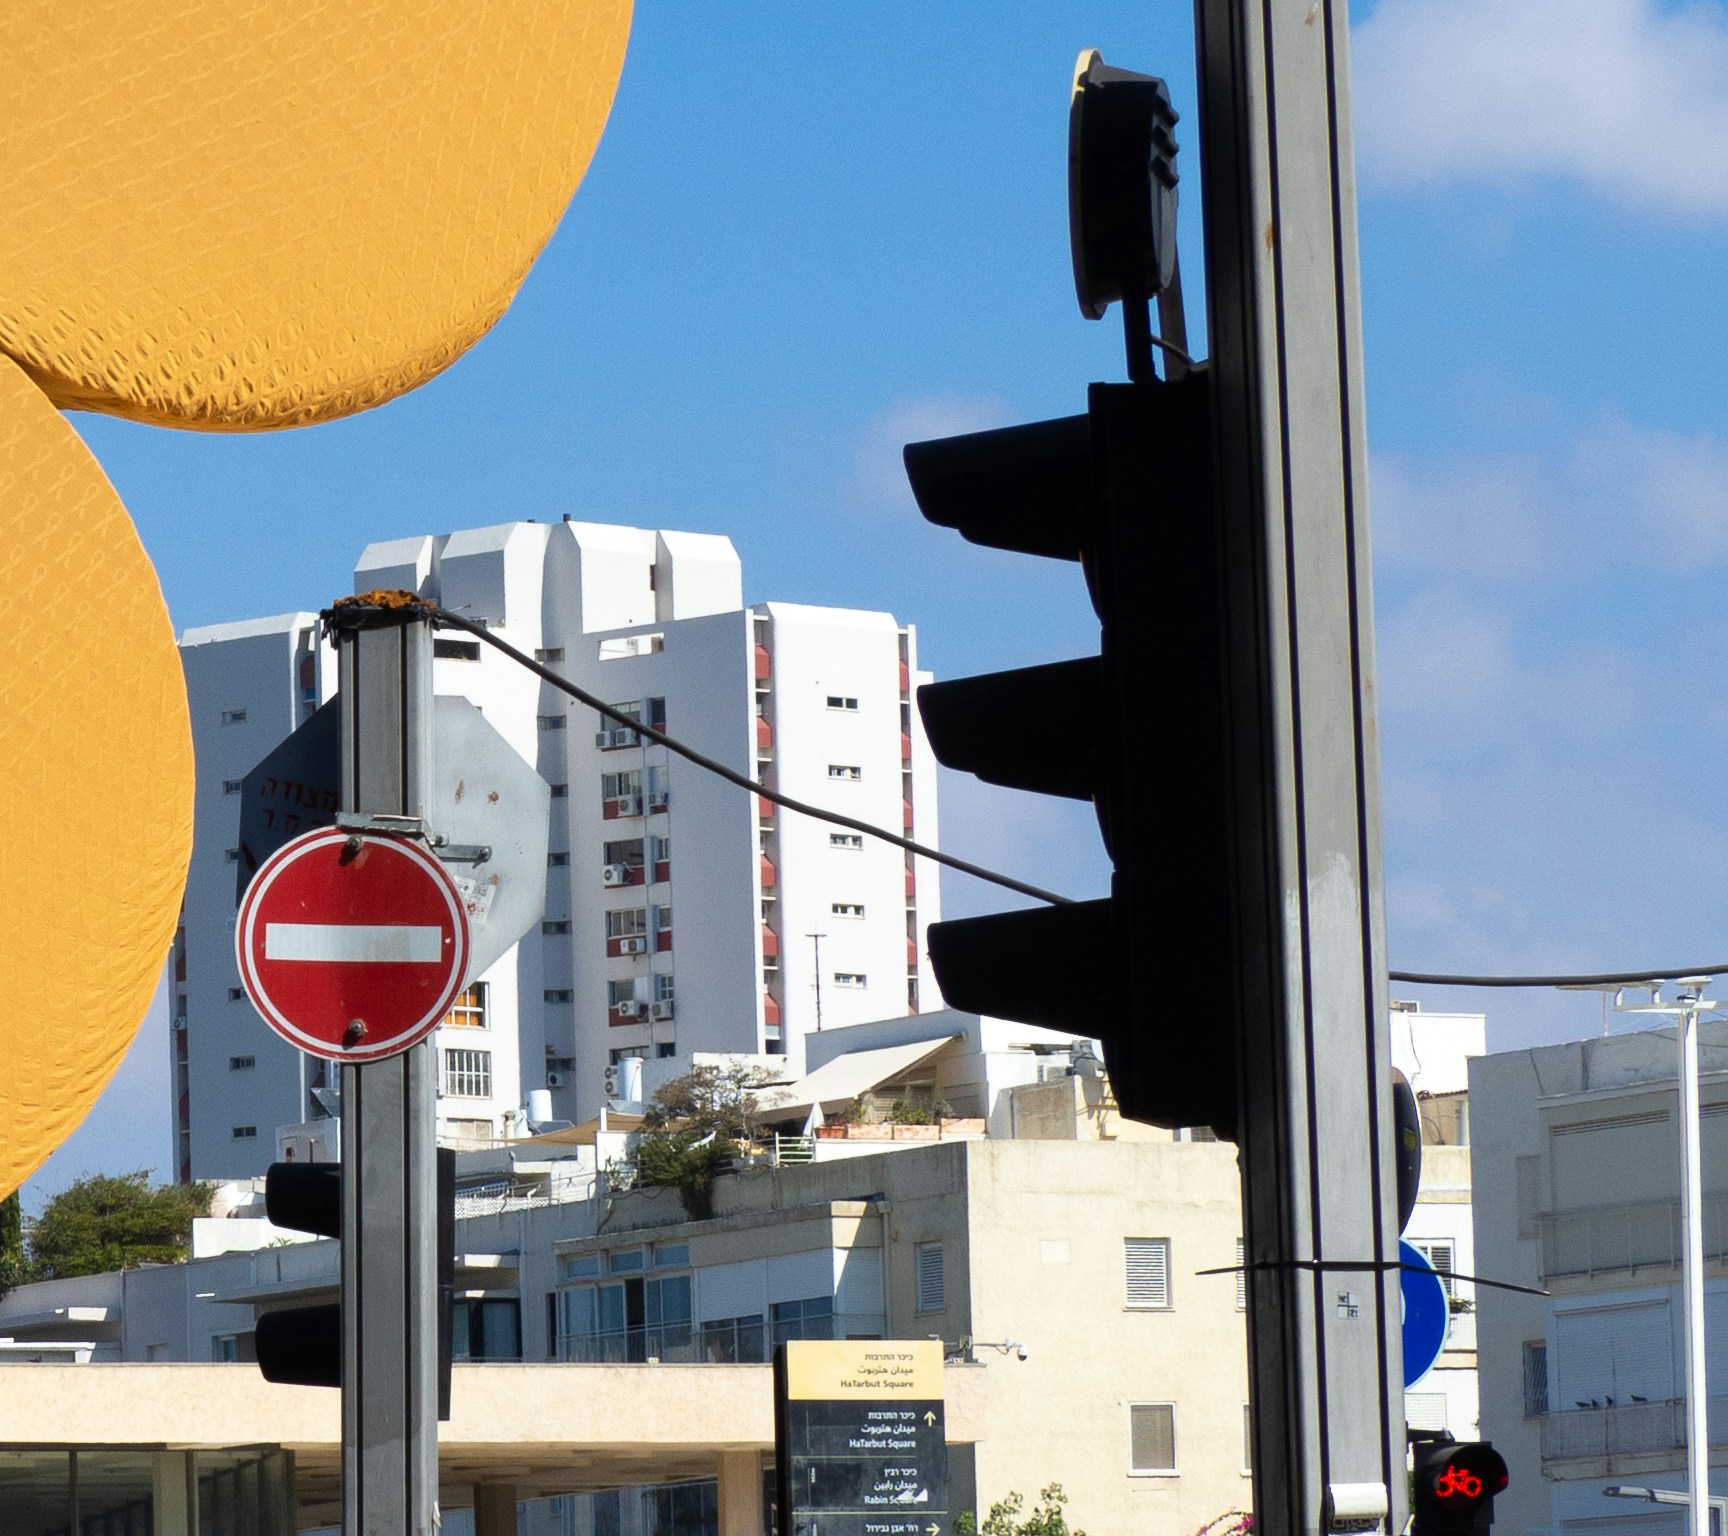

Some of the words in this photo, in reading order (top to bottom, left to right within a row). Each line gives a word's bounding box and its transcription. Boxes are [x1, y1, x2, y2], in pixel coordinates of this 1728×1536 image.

[898, 1353, 914, 1361] כיכר
[840, 1380, 880, 1388] HaTarbut
[883, 1380, 914, 1389] Square
[848, 1438, 886, 1448] HaTarbut
[887, 1438, 917, 1449] Square
[864, 1495, 888, 1504] Rabin
